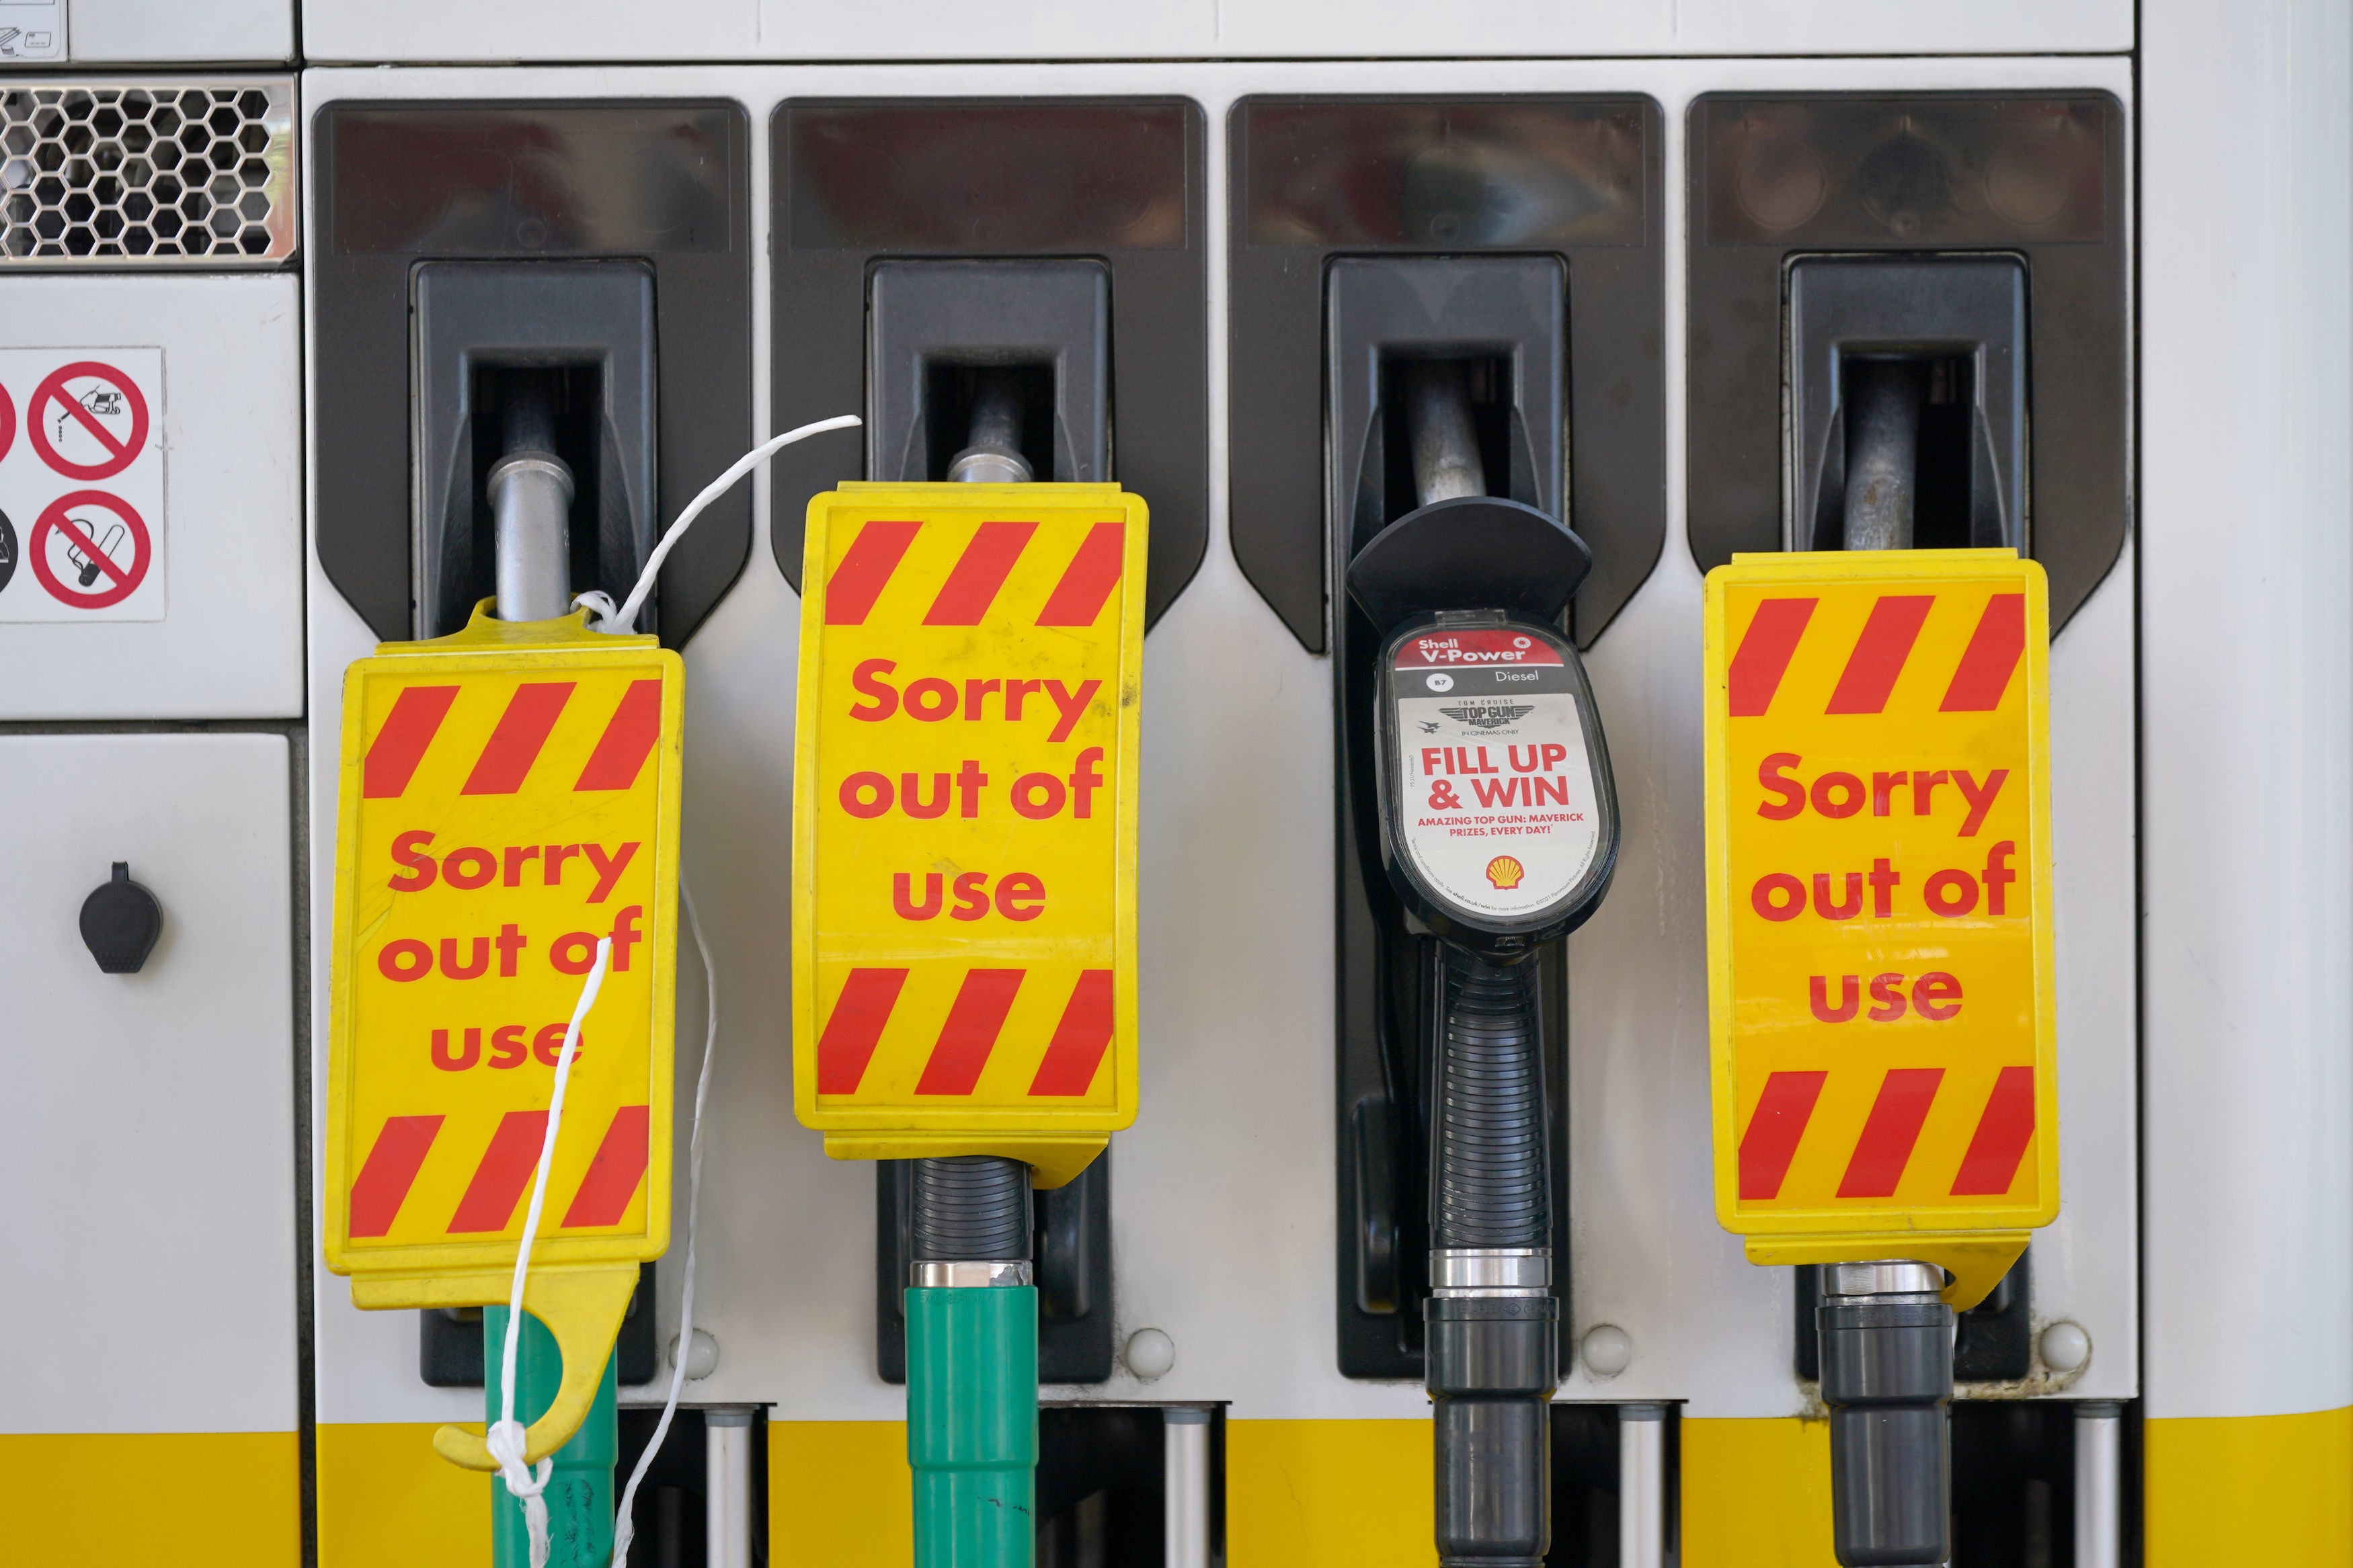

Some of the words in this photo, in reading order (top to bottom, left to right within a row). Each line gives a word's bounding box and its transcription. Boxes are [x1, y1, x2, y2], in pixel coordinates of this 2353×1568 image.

[1419, 638, 1459, 649] Shell
[1420, 649, 1526, 663] V-Power
[1495, 670, 1539, 682] Diesel
[849, 659, 1103, 743] Sorry
[1462, 706, 1486, 718] TOP
[1488, 706, 1515, 717] GUN
[1468, 717, 1510, 726] MAVERICK
[1421, 746, 1499, 776] FILL
[1508, 743, 1567, 774] UP
[838, 760, 988, 819] out
[1010, 747, 1104, 819] of
[1428, 779, 1464, 811] &
[1470, 776, 1570, 808] WIN
[1757, 752, 2010, 837] Sorry
[1418, 817, 1472, 826] AMAZING
[1474, 815, 1495, 825] TOP
[1498, 815, 1526, 824] GUN:
[1529, 813, 1584, 823] MAVERICK
[1449, 827, 1488, 837] PRIZES,
[1490, 826, 1523, 835] EVERY
[387, 830, 641, 904] Sorry
[1751, 858, 1901, 922] out
[1923, 840, 2016, 918] of
[893, 872, 1046, 922] use
[1453, 892, 1490, 909] shell.co.uk/win
[1550, 882, 1570, 898] Paramount
[378, 924, 527, 983] out
[549, 905, 643, 981] of
[1809, 972, 1963, 1024] use
[431, 1023, 584, 1072] use
